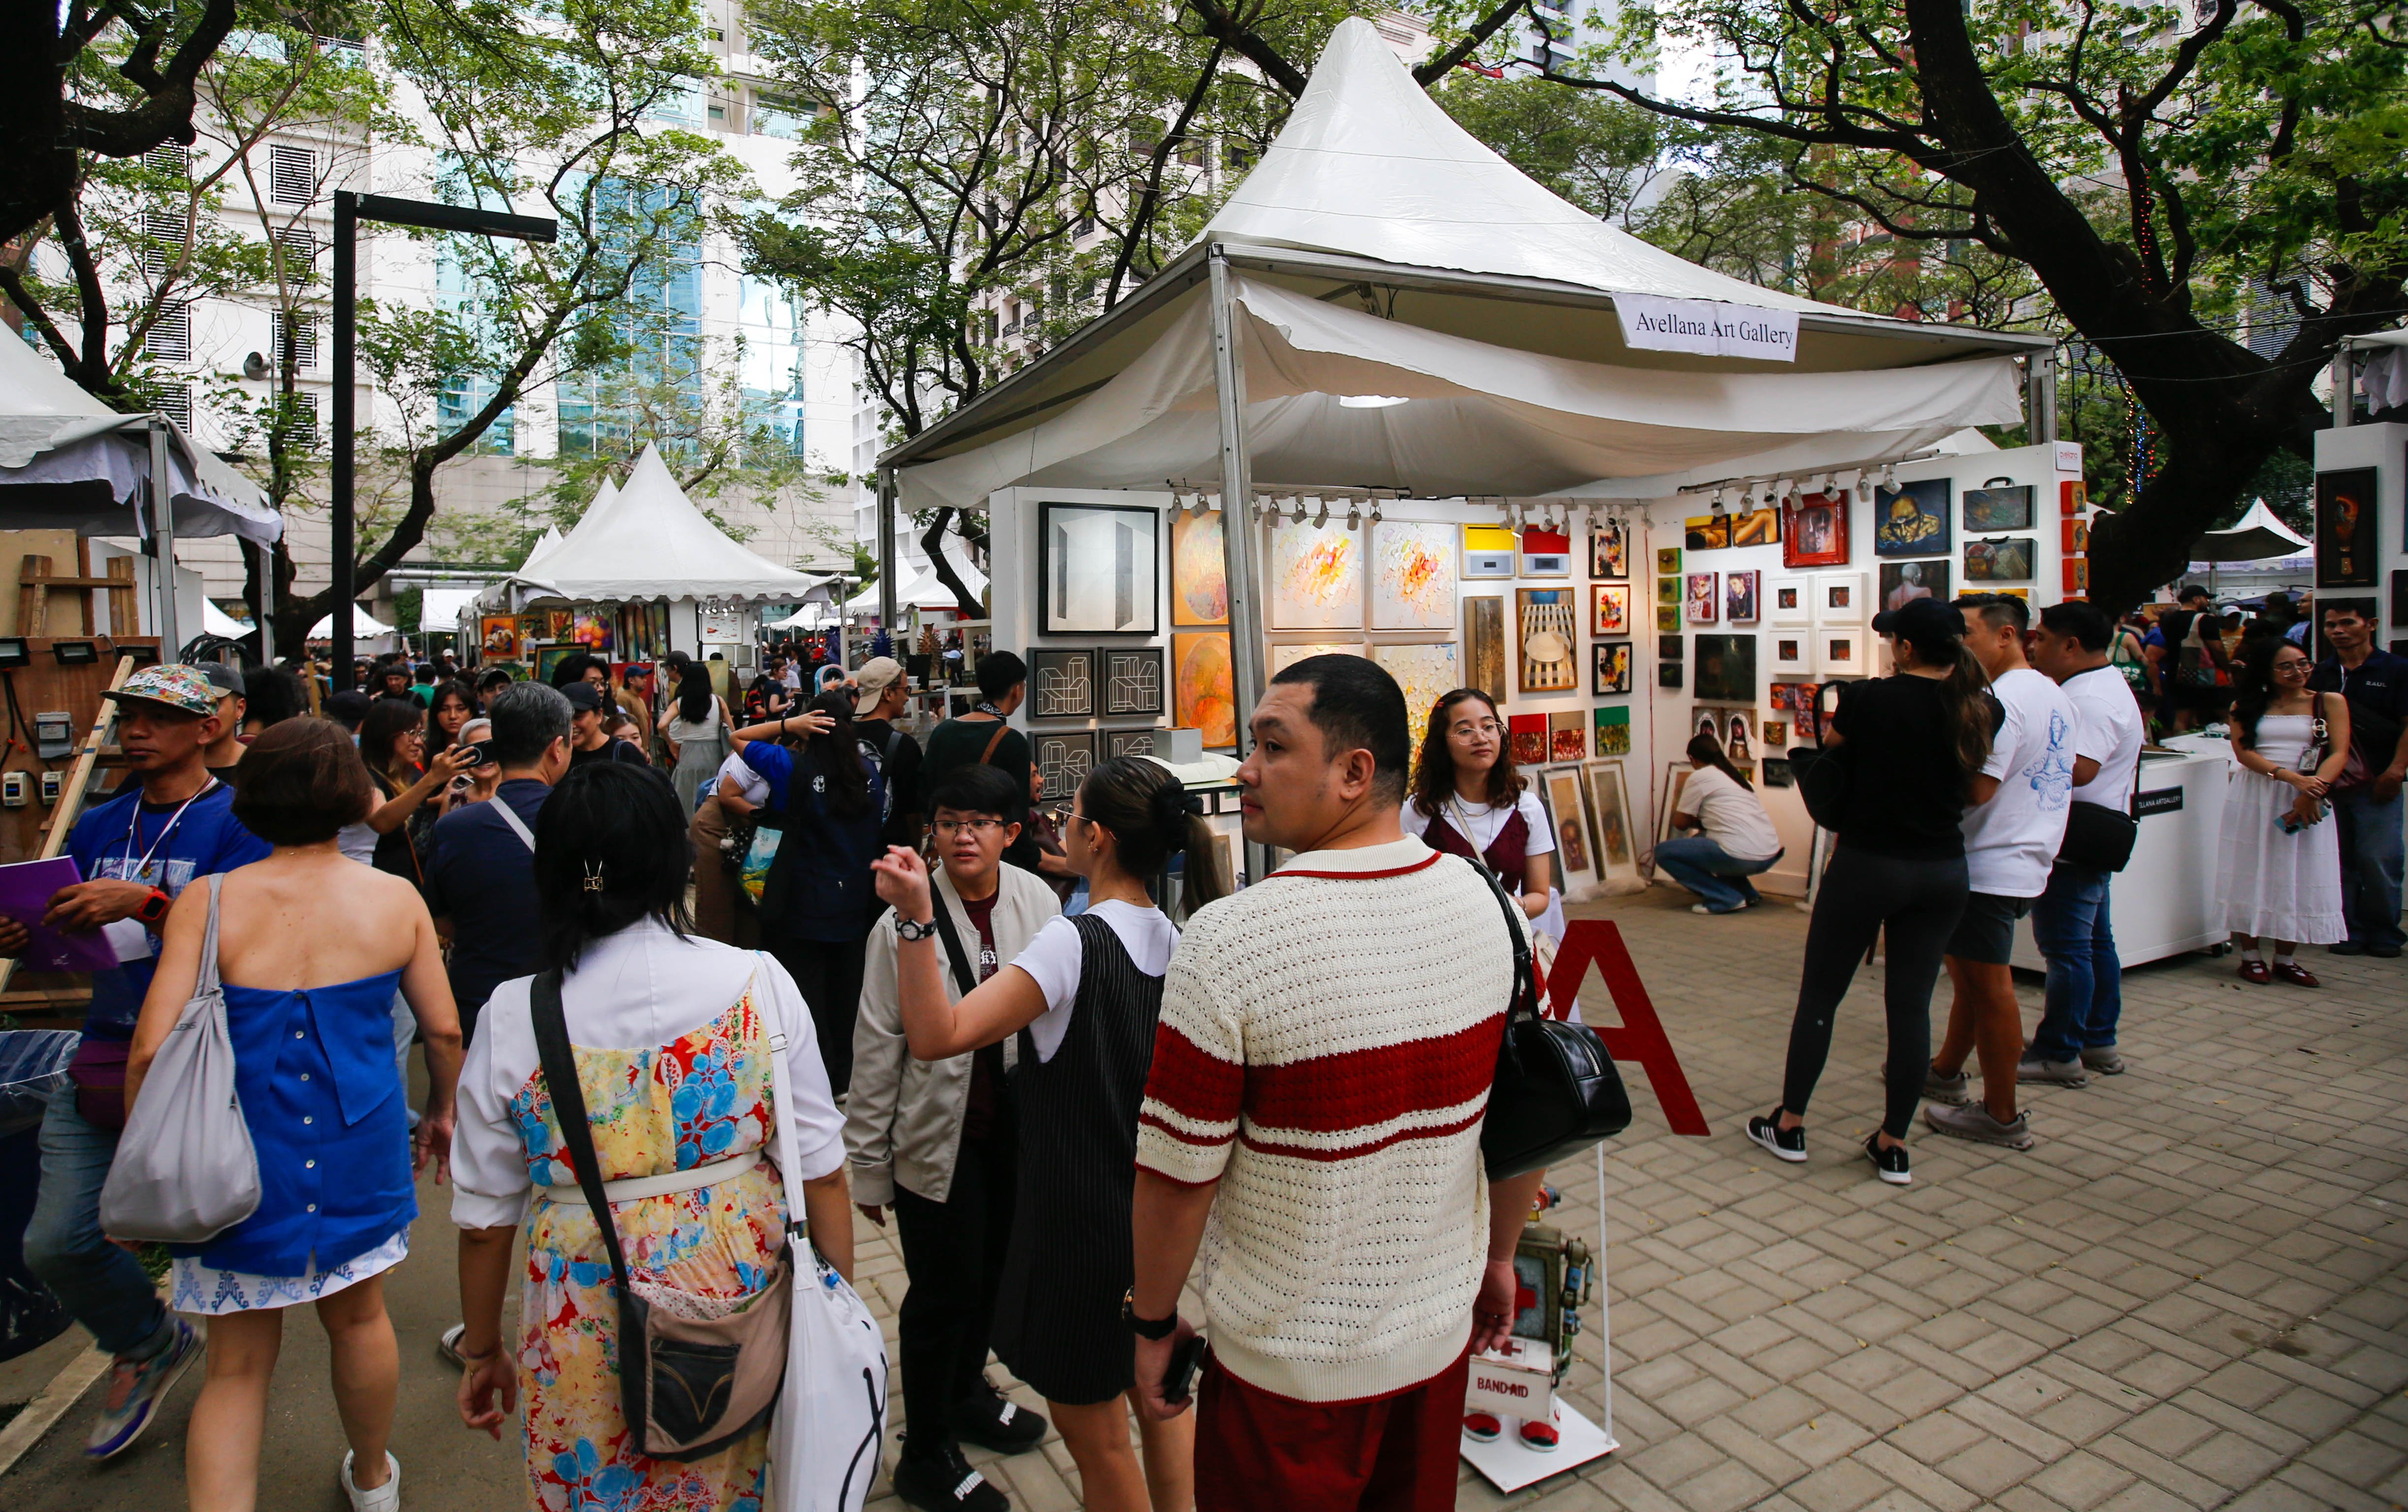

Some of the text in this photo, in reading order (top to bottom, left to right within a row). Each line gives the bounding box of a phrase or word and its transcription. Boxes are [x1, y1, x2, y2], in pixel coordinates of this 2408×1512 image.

[1636, 312, 1793, 349] Avellana Art Gallery
[2138, 799, 2155, 809] ELLANA
[1477, 1377, 1529, 1398] BAND-AID
[999, 1402, 1017, 1426] PUMA
[954, 1471, 984, 1501] PUMA
